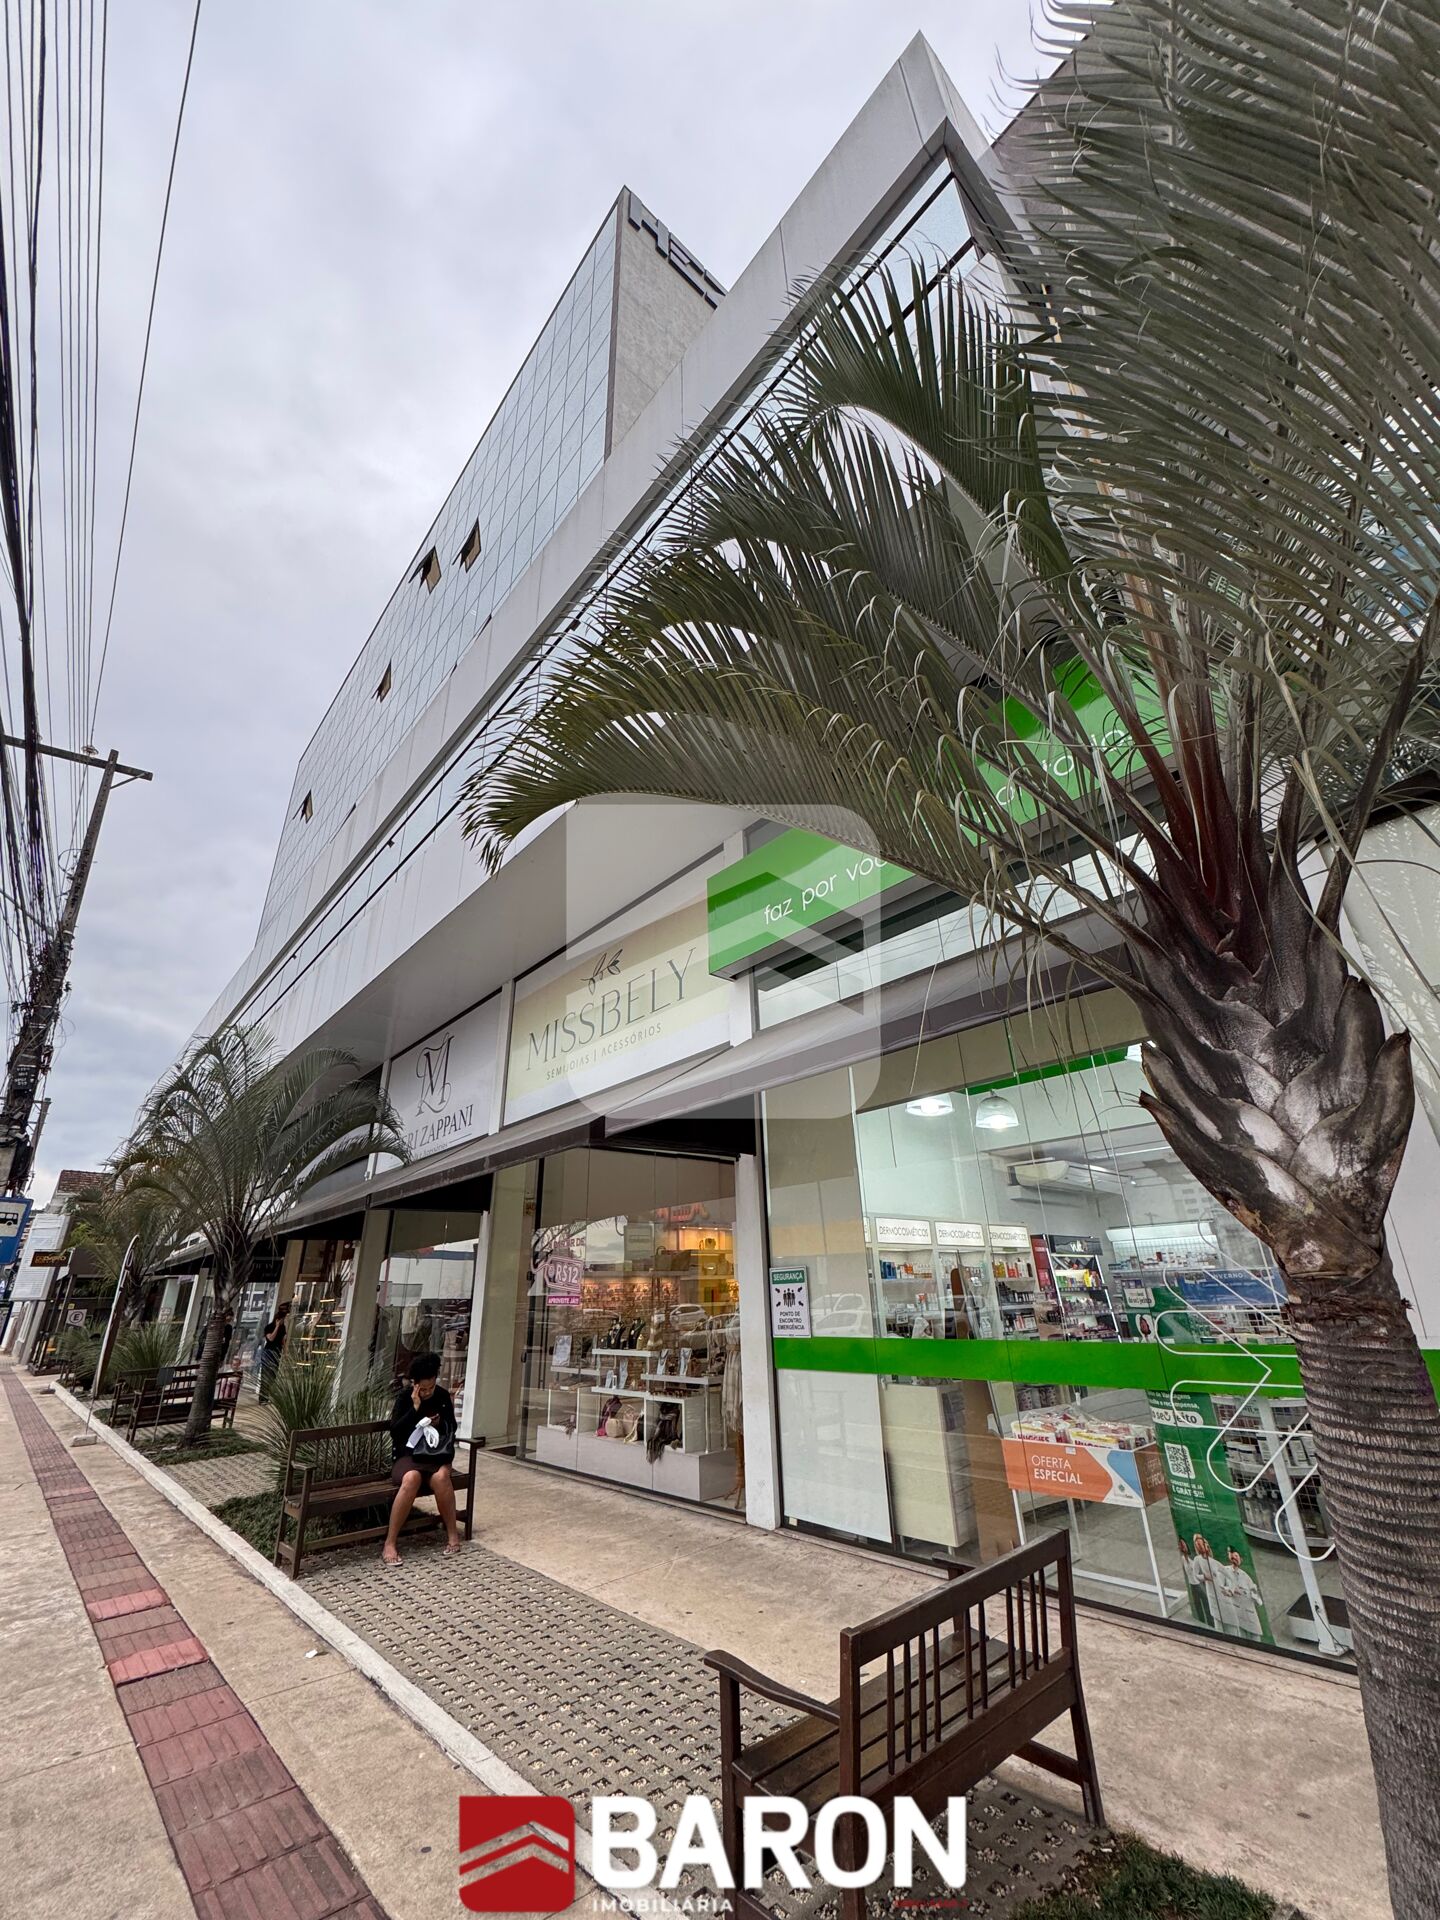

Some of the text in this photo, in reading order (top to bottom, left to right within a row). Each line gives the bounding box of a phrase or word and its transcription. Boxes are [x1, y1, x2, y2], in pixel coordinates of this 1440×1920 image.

[763, 855, 889, 926] faz por voc
[525, 946, 697, 1072] MISSBELY
[601, 1021, 663, 1058] ACESSÓRIOS
[420, 1103, 474, 1148] ZAPPANI
[878, 1225, 930, 1238] DERMOCOSMÉTICOS
[938, 1228, 984, 1241] DERMOCOSMÉTICOS
[772, 1271, 804, 1282] SEGURANÇA
[1031, 1454, 1073, 1471] OFERTA
[1034, 1467, 1084, 1486] ESPECIAL
